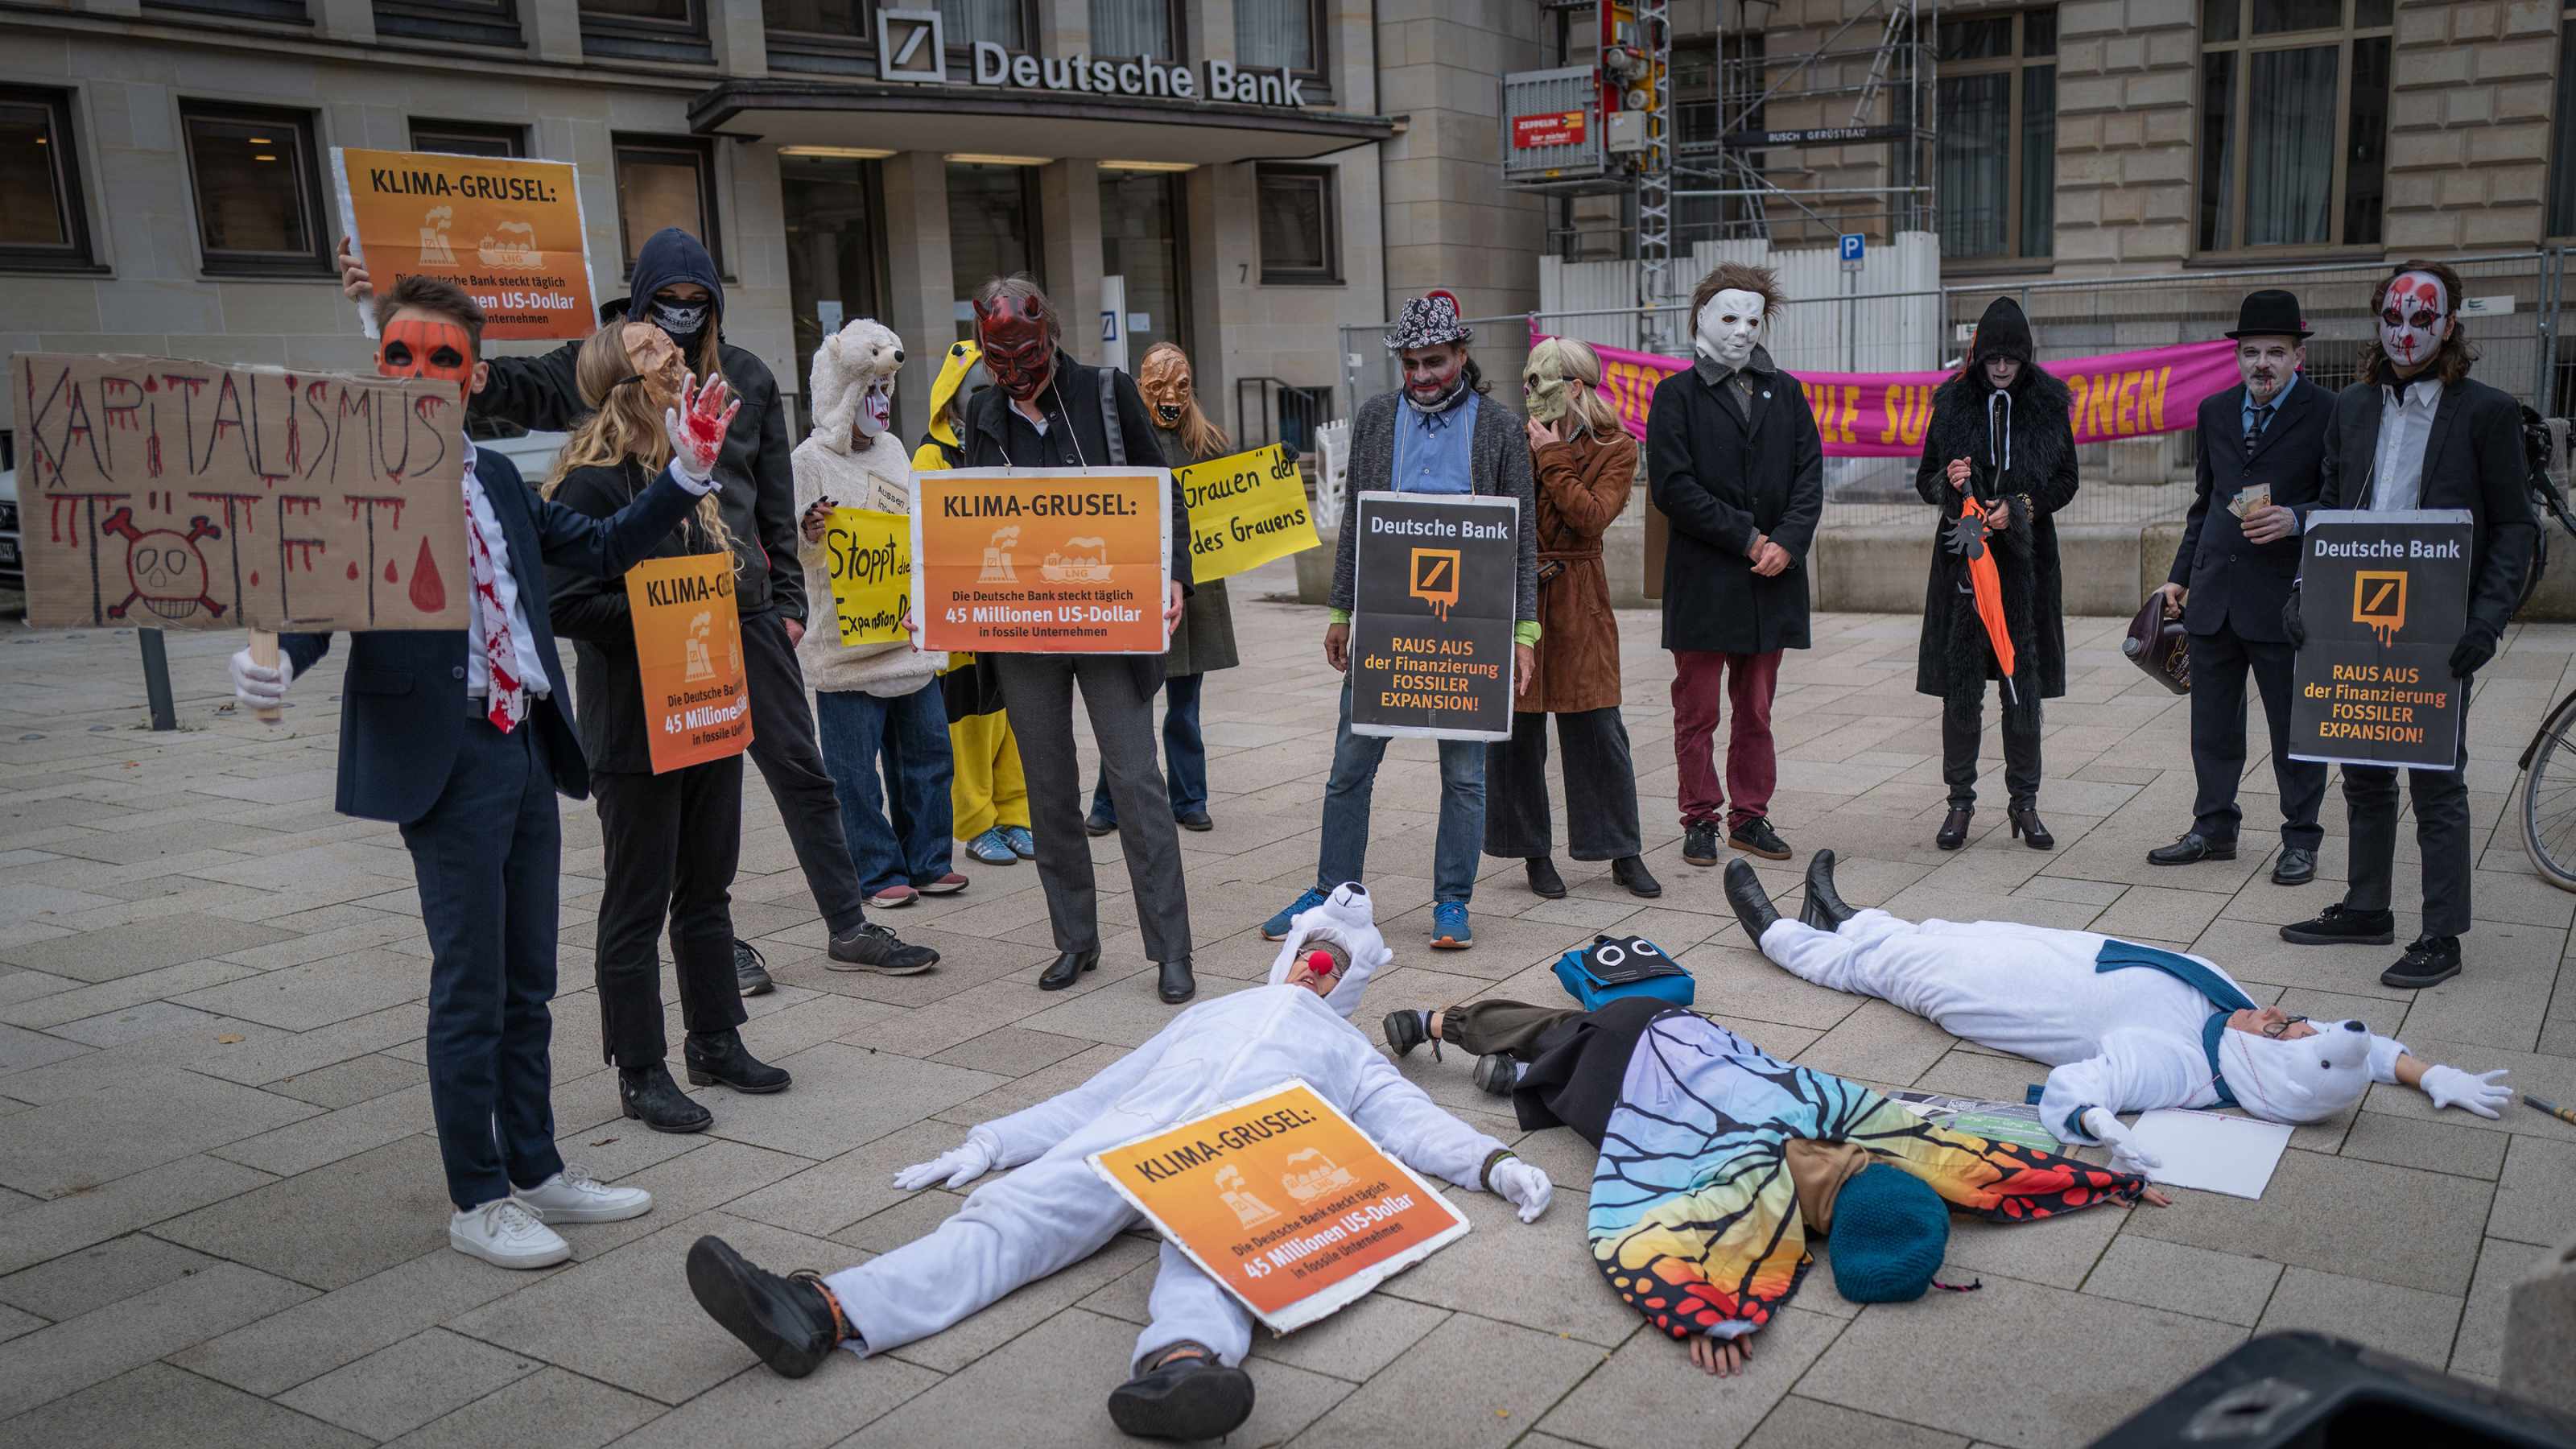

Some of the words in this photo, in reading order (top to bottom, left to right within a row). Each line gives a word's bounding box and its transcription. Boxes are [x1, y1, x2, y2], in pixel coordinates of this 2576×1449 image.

[972, 41, 1195, 97] Deutsche
[1204, 60, 1306, 106] Bank
[1769, 132, 1800, 142] BUSCH
[1807, 128, 1867, 139] GERÜSTBAU
[370, 168, 557, 203] KLIMA-GRUSEL:
[1845, 238, 1859, 258] P
[470, 275, 497, 286] Bank
[498, 277, 530, 287] steckt
[532, 277, 566, 289] täglich
[1238, 264, 1248, 283] 7
[502, 293, 575, 309] US-Dollar
[488, 312, 548, 324] nternehmen
[1270, 449, 1295, 480] der
[944, 494, 1137, 517] KLIMA-GRUSEL:
[1193, 530, 1224, 554] des
[1230, 509, 1306, 543] Grauens
[1372, 517, 1456, 537] Deutsche
[1462, 521, 1508, 539] Bank
[828, 529, 896, 584] Stoppt
[898, 555, 910, 575] die
[2315, 539, 2404, 557] Deutsche
[2409, 540, 2460, 559] Bank
[1065, 568, 1088, 578] LNG
[952, 592, 970, 601] Die
[973, 591, 1025, 601] Deutsche
[1028, 591, 1055, 601] Bank
[1058, 591, 1092, 601] steckt
[1094, 590, 1133, 602] täglich
[946, 607, 967, 623] 45
[973, 606, 1053, 623] Millionen
[1059, 605, 1141, 622] US-Dollar
[979, 626, 989, 637] in
[993, 626, 1029, 637] fossile
[1032, 626, 1107, 637] Unternehmen
[1393, 638, 1436, 654] RAUS
[1440, 641, 1474, 655] AUS
[1365, 654, 1391, 670] der
[1396, 657, 1499, 679] Finanzierung
[2333, 665, 2379, 681] RAUS
[2383, 667, 2419, 683] AUS
[1393, 675, 1469, 692] FOSSILER
[667, 694, 682, 708] Die
[683, 687, 721, 704] Deutsche
[1381, 692, 1478, 712] EXPANSION!
[2305, 683, 2331, 698] der
[2335, 685, 2447, 708] Finanzierung
[666, 713, 682, 734] 45
[2332, 704, 2413, 723] FOSSILER
[692, 734, 700, 745] in
[703, 728, 729, 743] fossile
[2319, 721, 2423, 743] EXPANSION!
[1135, 1108, 1318, 1183] KLIMA-GRUSEL:
[1232, 1239, 1254, 1257] Die
[1251, 1218, 1302, 1248] Deutsche
[1300, 1208, 1328, 1225] Bank
[1327, 1195, 1356, 1213] steckt
[1355, 1180, 1390, 1201] täglich
[1243, 1257, 1271, 1278] 45
[1266, 1226, 1348, 1267] Millionen
[1340, 1193, 1414, 1232] US-Dollar
[1290, 1266, 1305, 1279] in
[1304, 1252, 1342, 1274] fossile
[1338, 1222, 1404, 1256] Unternehmen
